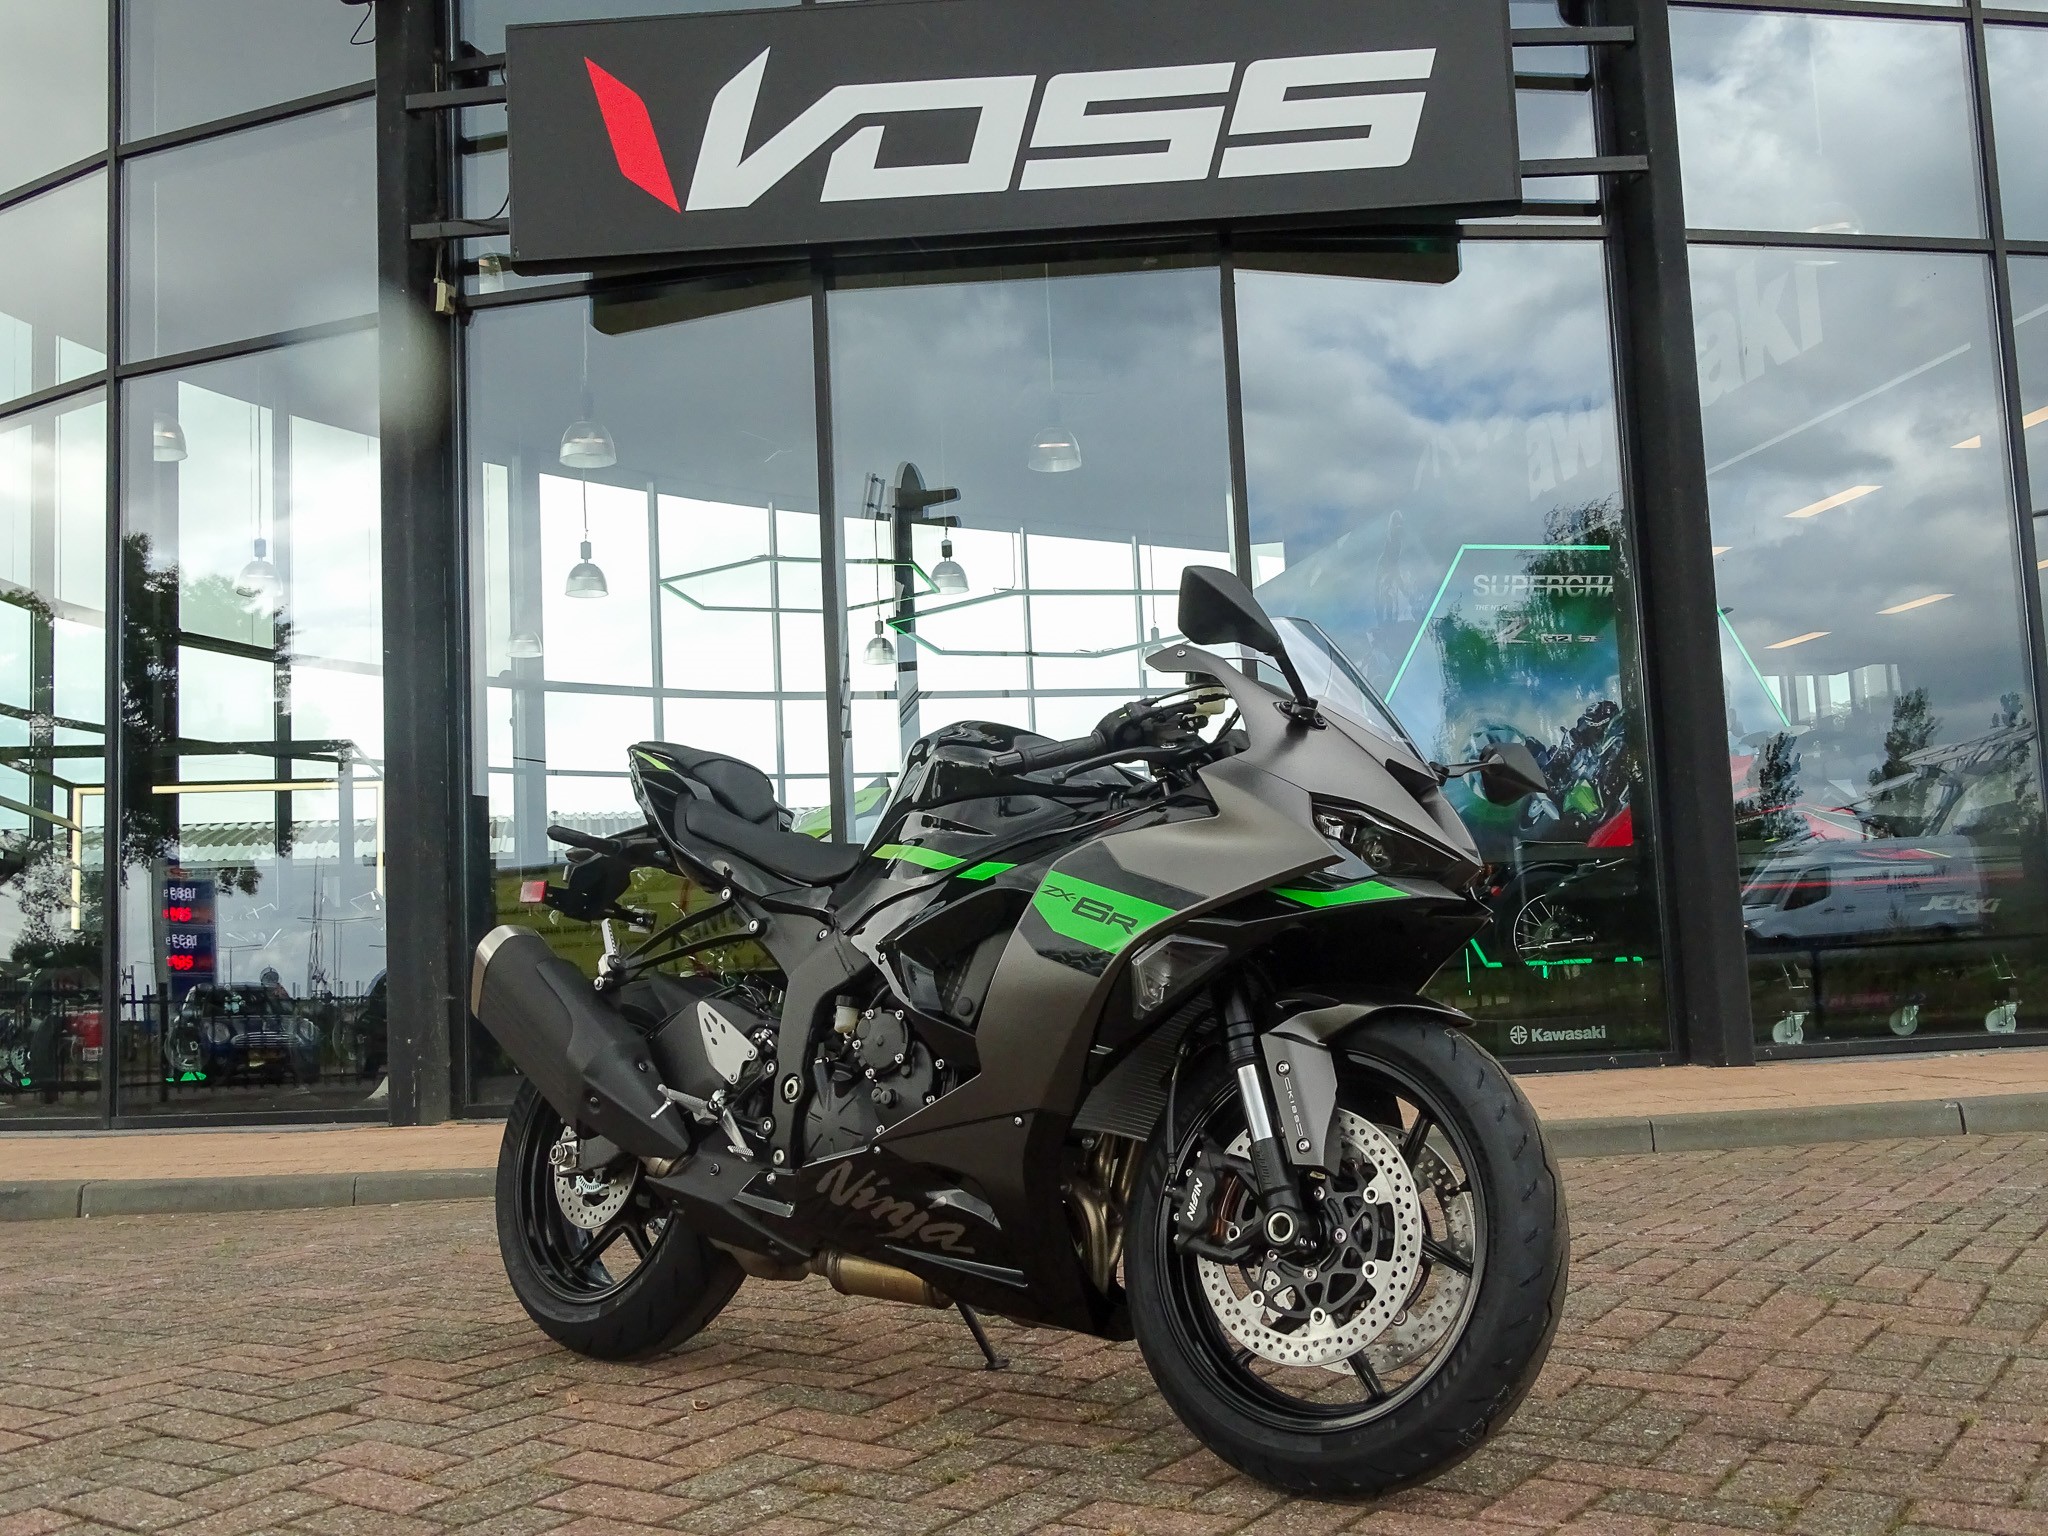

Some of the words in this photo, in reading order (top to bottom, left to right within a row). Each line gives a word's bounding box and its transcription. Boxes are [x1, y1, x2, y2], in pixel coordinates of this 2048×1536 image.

[584, 46, 1437, 214] VOSS
[1474, 604, 1489, 612] THE
[1040, 884, 1139, 936] ZX-6R
[1531, 1025, 1607, 1043] Kawasaki
[815, 1159, 976, 1254] Ninja
